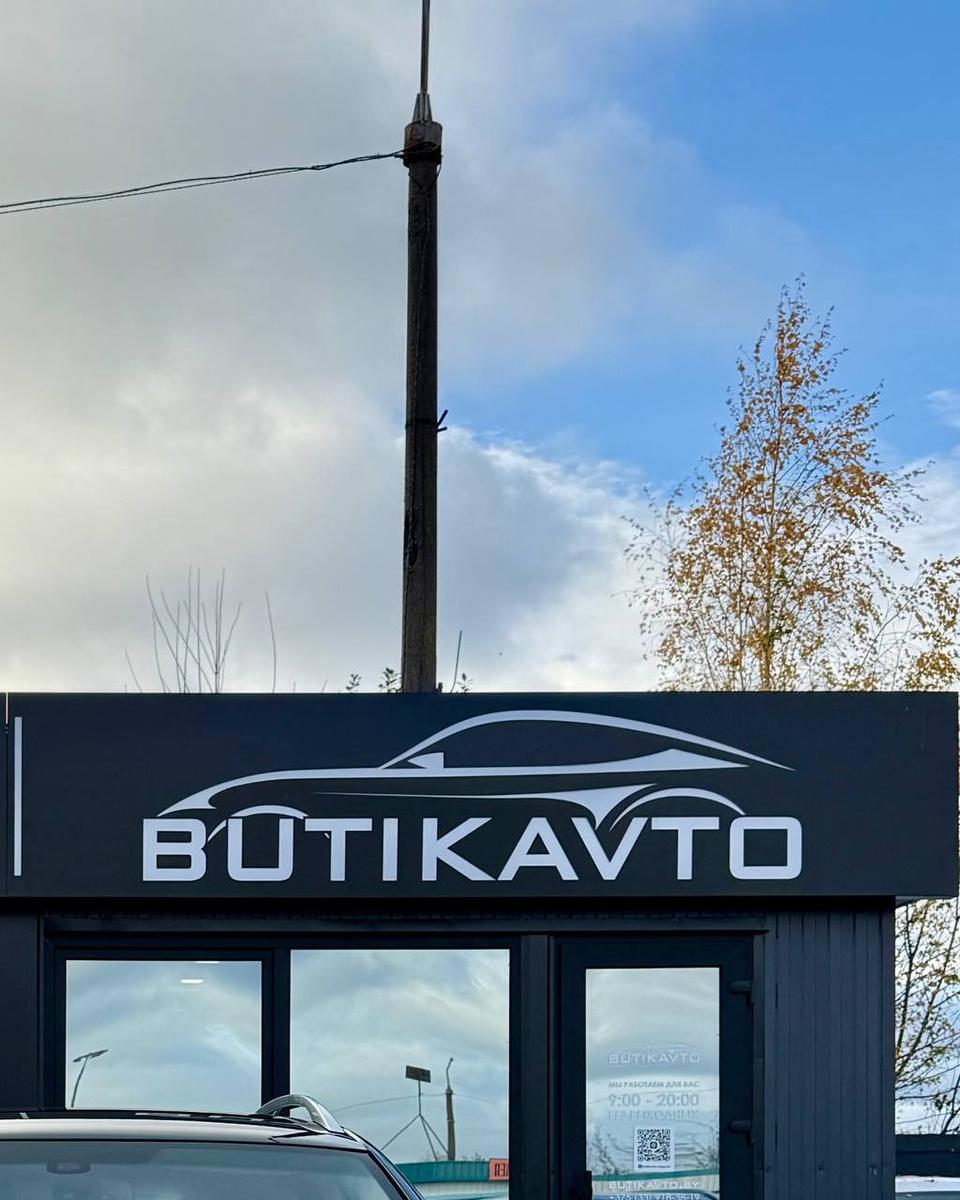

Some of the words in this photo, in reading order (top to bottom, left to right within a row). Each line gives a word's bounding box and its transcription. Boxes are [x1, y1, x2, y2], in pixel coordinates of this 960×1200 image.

[142, 815, 803, 882] BUTIKAVTO
[608, 1093, 641, 1107] 9:00
[656, 1093, 699, 1107] 20:00
